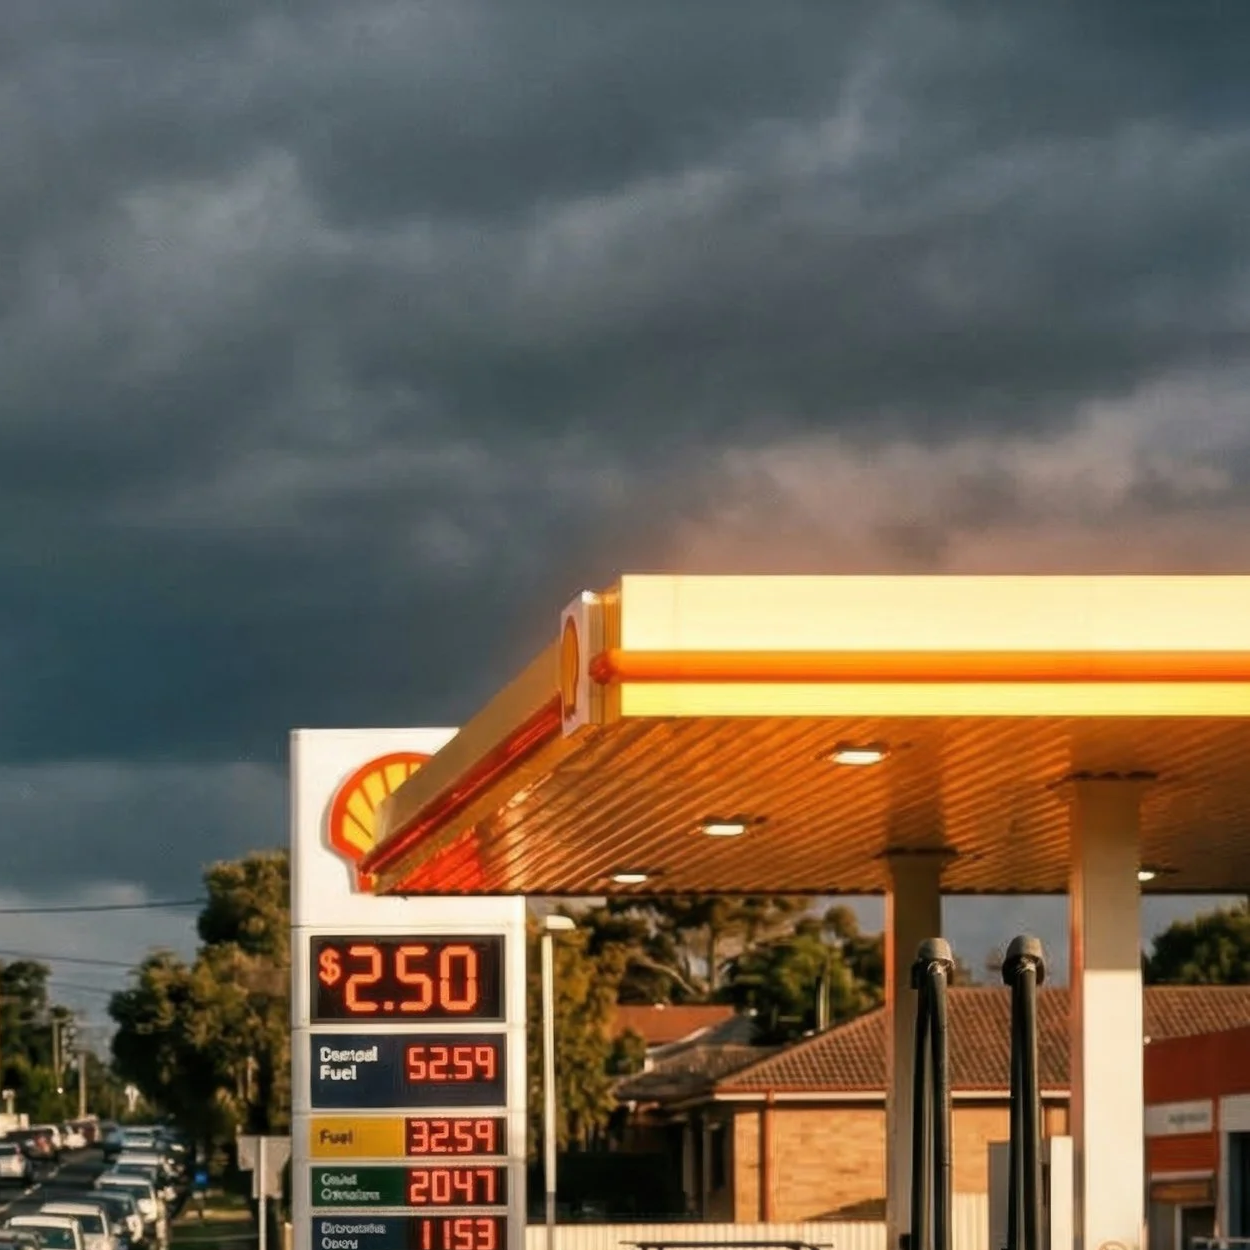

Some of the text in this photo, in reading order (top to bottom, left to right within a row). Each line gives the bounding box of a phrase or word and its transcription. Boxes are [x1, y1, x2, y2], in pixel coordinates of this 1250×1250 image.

[319, 945, 477, 1011] $2.50
[320, 1065, 357, 1080] Fuel
[410, 1170, 494, 1202] 2047
